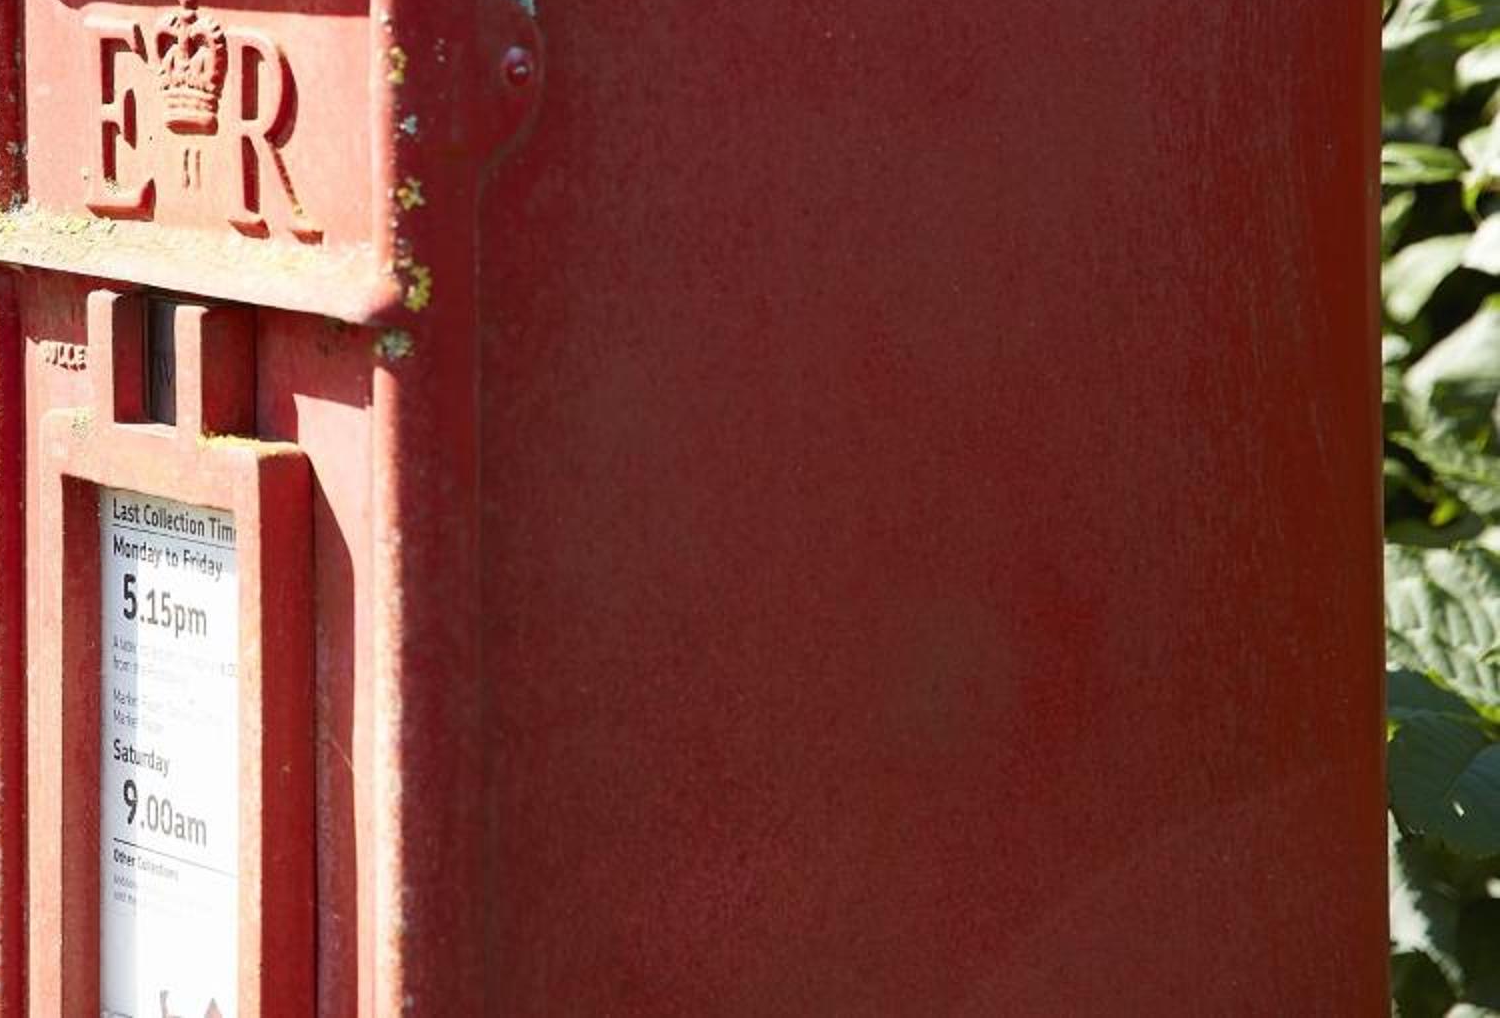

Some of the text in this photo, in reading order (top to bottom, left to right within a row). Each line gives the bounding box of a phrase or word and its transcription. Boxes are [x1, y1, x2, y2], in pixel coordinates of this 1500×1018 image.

[112, 497, 140, 524] Last
[143, 504, 205, 537] Collection
[112, 533, 222, 583] Monday to Friday
[123, 573, 207, 639] 5.15pm
[112, 738, 170, 778] Saturday
[123, 779, 207, 848] 9.00am
